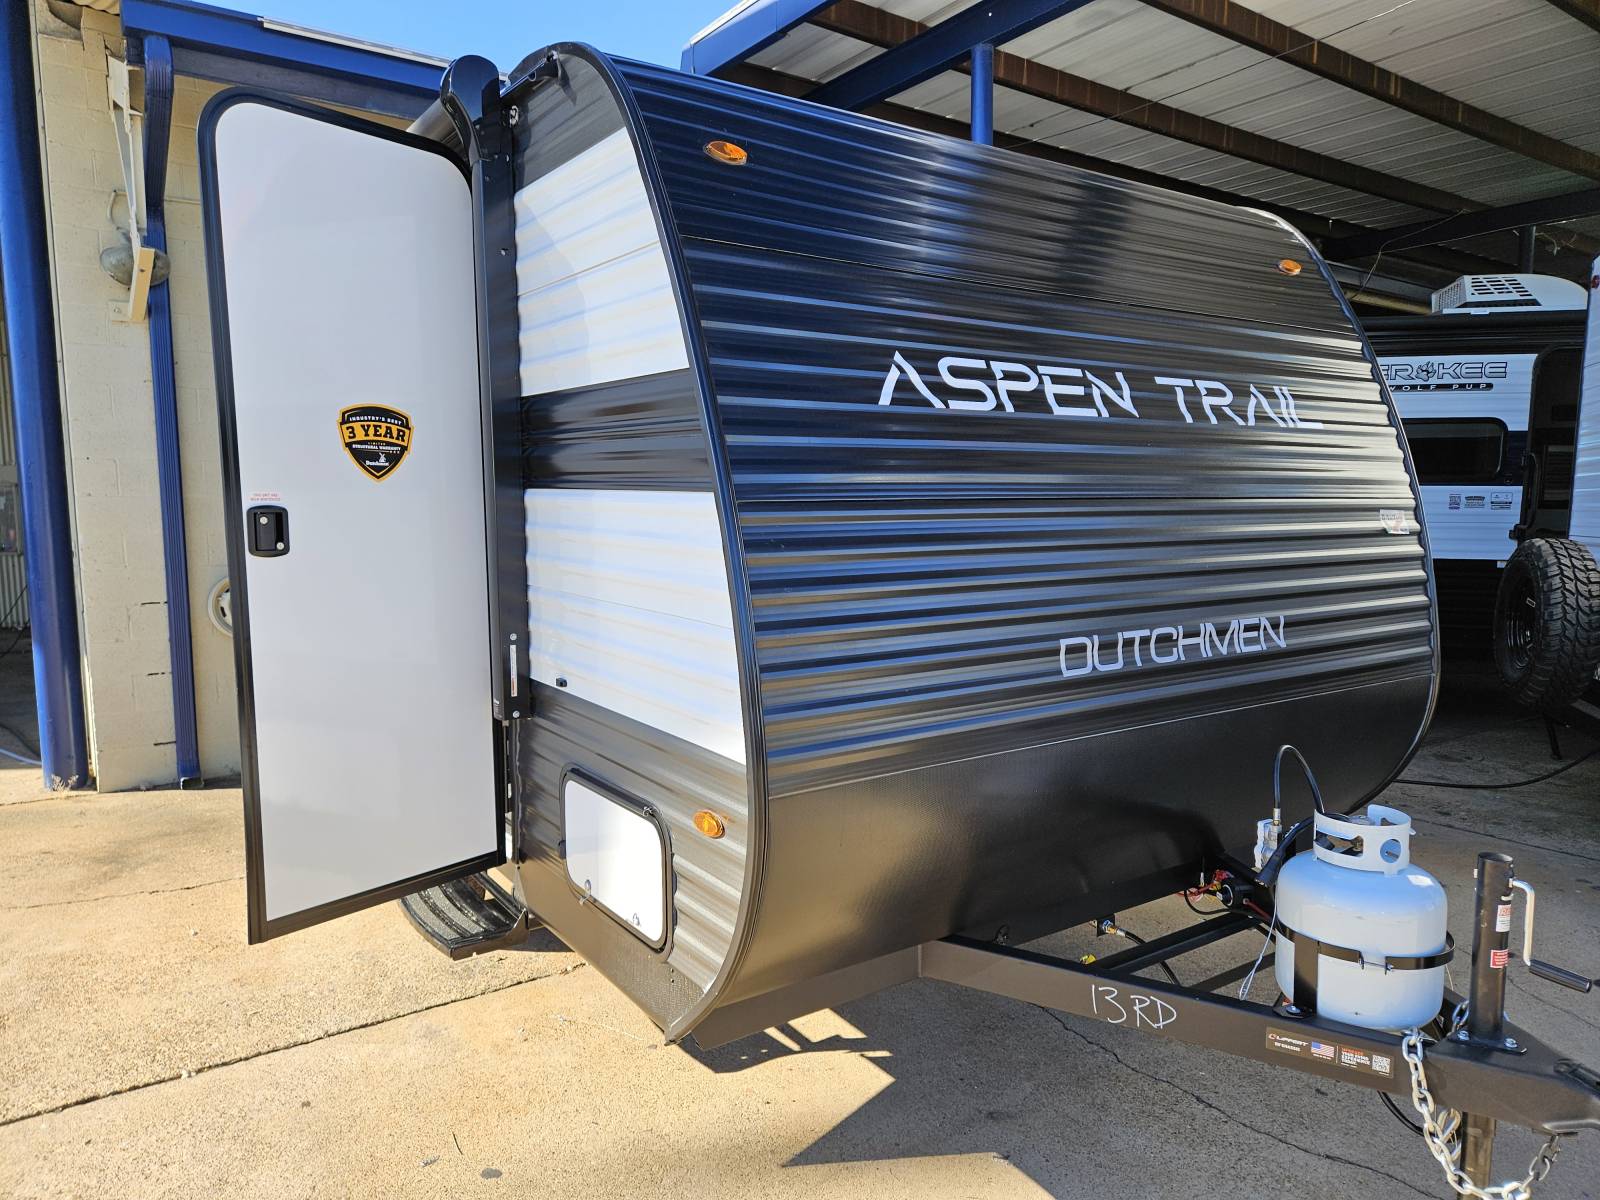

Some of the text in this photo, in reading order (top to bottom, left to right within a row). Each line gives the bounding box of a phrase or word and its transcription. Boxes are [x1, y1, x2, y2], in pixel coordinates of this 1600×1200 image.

[878, 350, 1325, 429] ASPEN TRAIL
[1452, 383, 1488, 391] PUP
[345, 424, 406, 442] 3 YEAR
[1059, 615, 1287, 677] DUTCHMEN
[1130, 995, 1177, 1030] RD
